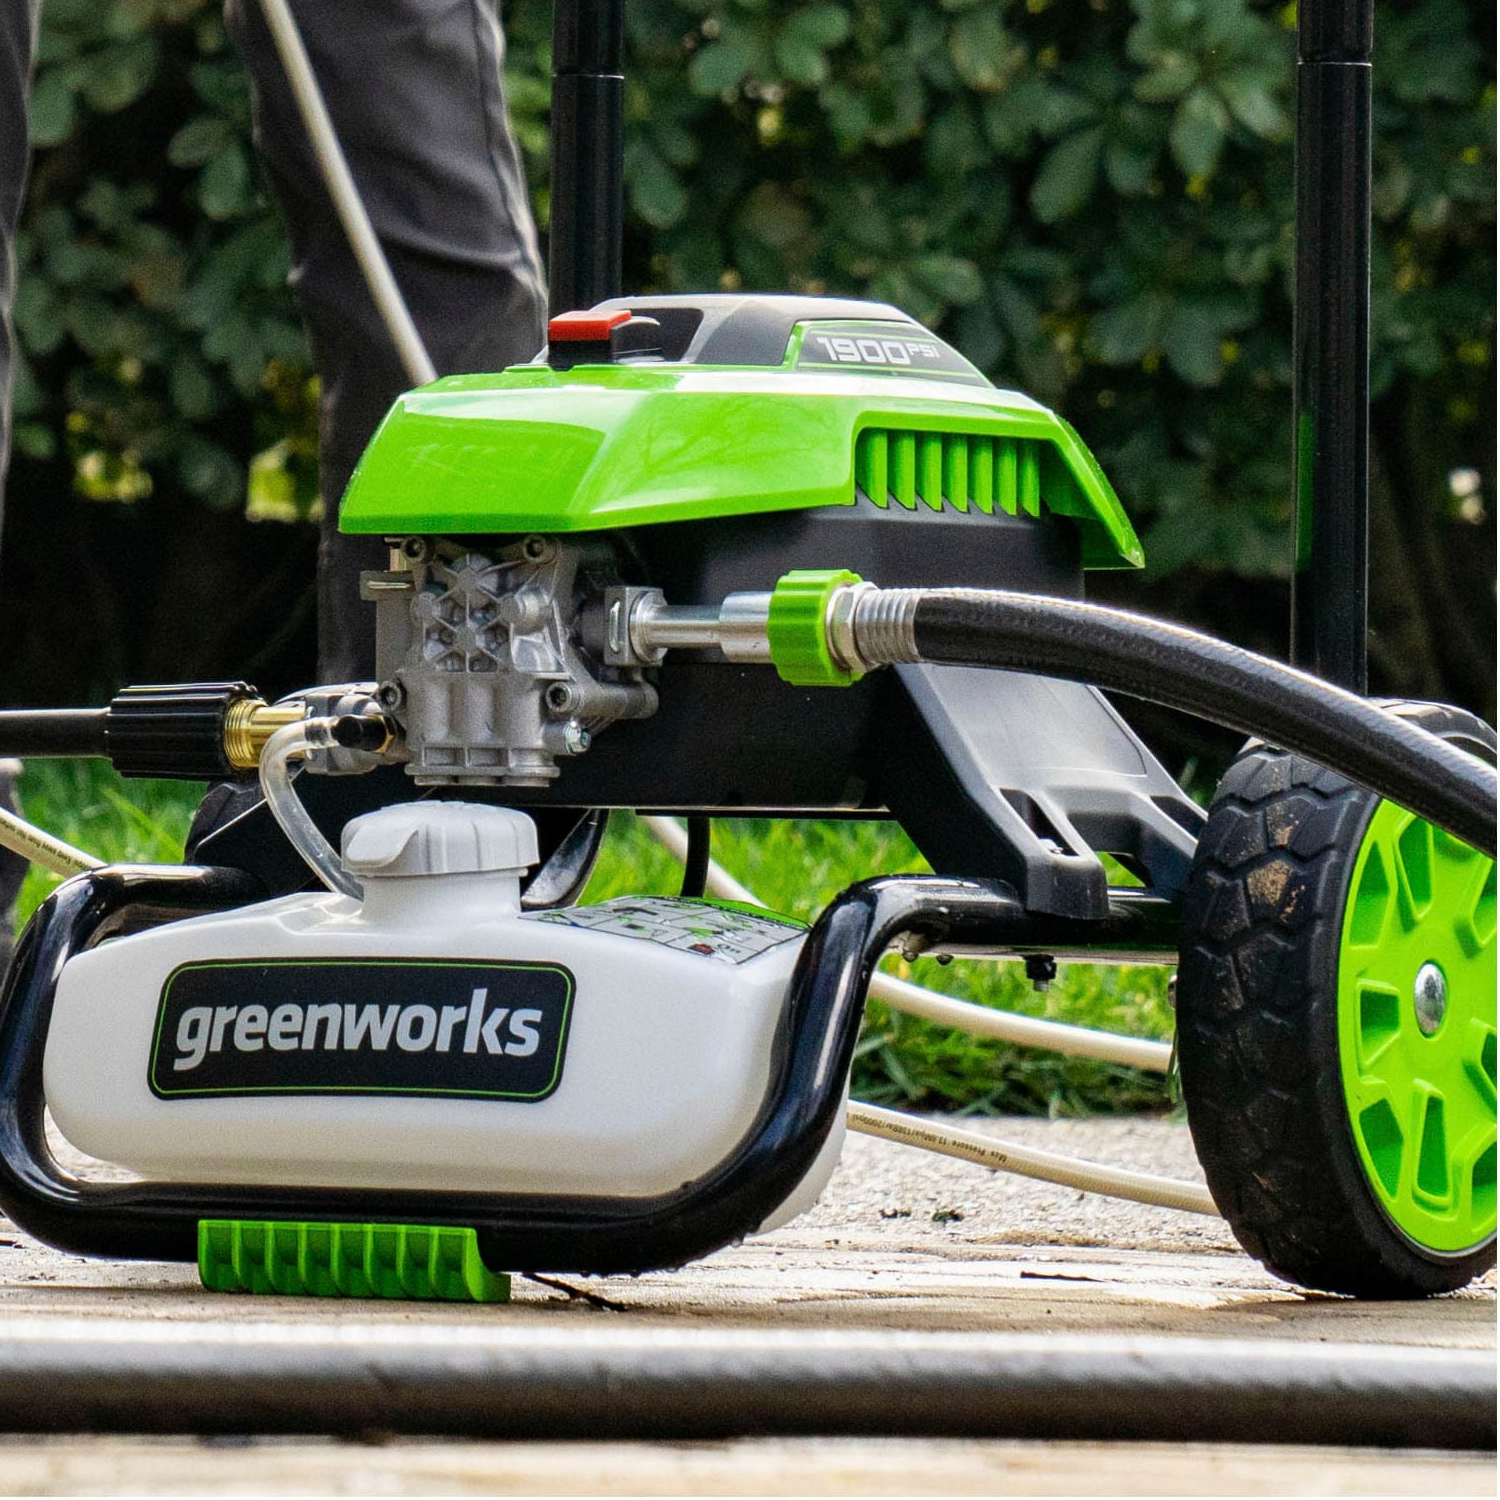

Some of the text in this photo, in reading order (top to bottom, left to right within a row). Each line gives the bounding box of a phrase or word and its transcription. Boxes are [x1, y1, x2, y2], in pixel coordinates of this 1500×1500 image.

[816, 337, 940, 365] 1900 PSI
[173, 988, 543, 1071] greenworks
